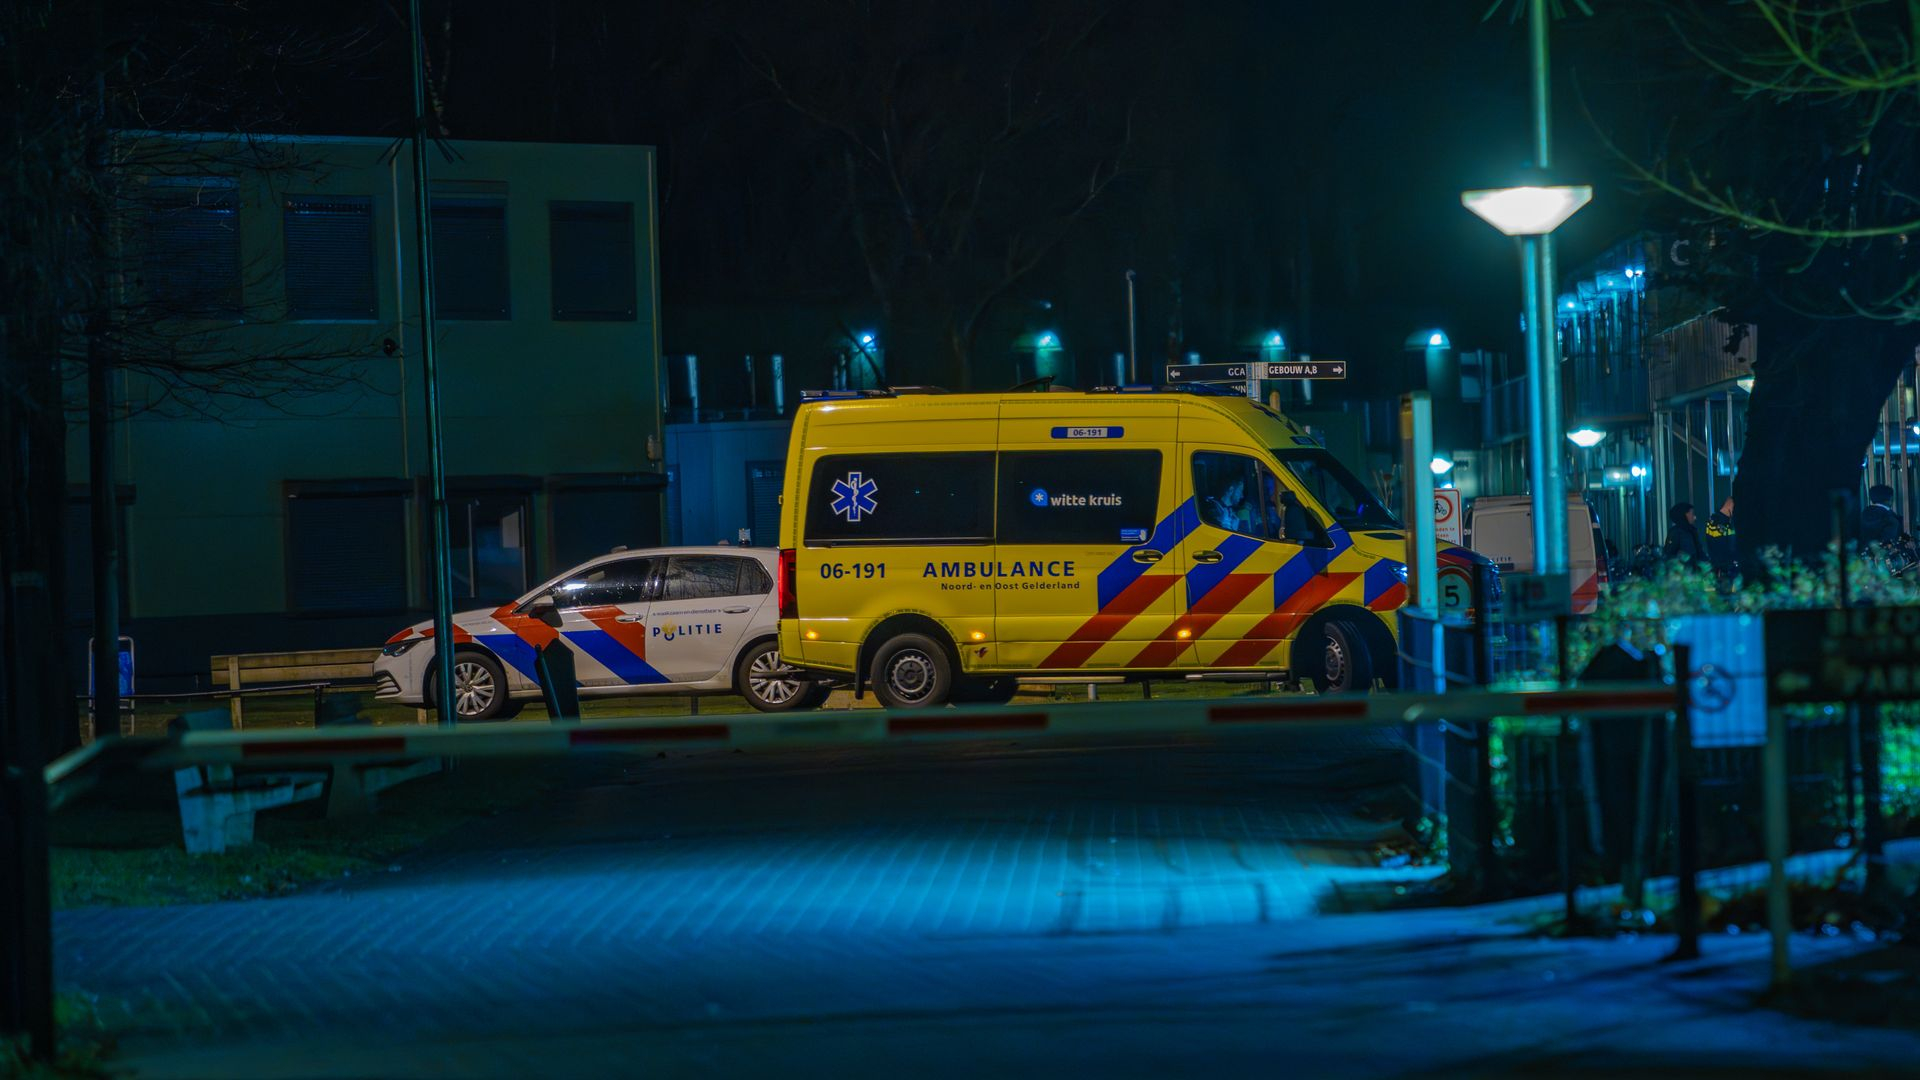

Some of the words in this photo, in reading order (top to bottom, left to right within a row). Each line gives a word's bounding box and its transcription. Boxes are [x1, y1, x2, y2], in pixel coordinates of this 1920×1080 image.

[1670, 239, 1691, 266] C
[1228, 367, 1246, 377] GCA
[1268, 366, 1303, 375] GEBOUW
[1304, 365, 1318, 375] A,B
[1050, 493, 1087, 507] witte
[1088, 492, 1123, 507] kruis
[820, 562, 887, 579] 06-191
[923, 561, 1076, 578] AMBULANCE
[941, 582, 977, 591] Noord-
[995, 582, 1019, 590] Oost
[1021, 581, 1081, 590] Gelderland
[1444, 584, 1460, 608] 5
